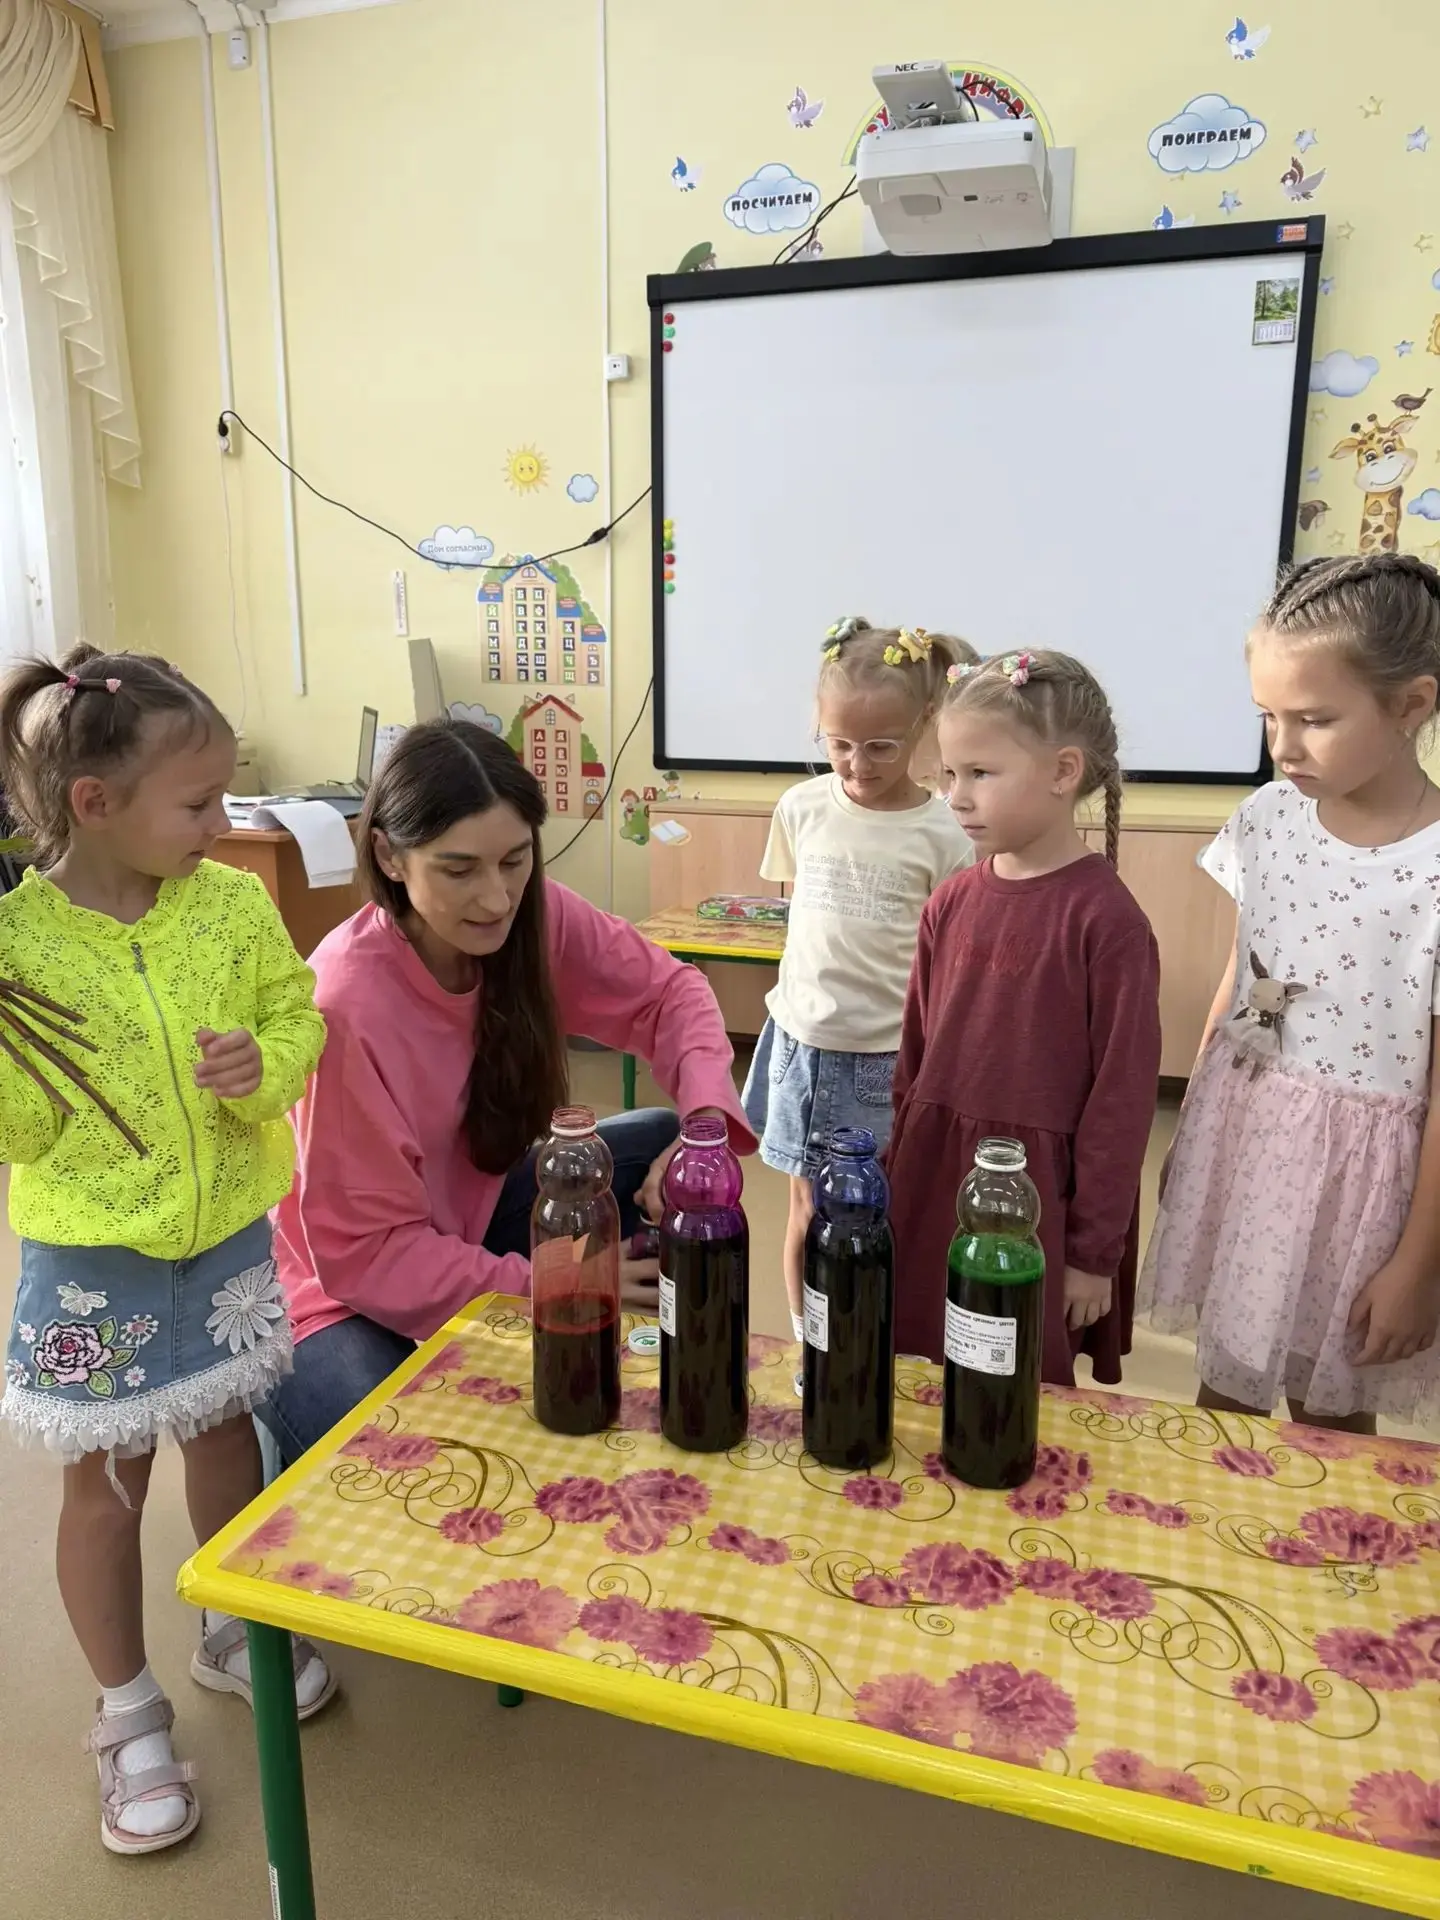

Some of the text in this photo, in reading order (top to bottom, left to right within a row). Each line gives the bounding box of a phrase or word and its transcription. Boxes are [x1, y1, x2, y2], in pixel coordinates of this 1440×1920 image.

[894, 62, 919, 72] NEC
[1161, 127, 1252, 147] ПОИГРАЕМ
[731, 192, 813, 212] ПОСЧИТАЕМ
[427, 543, 488, 554] Дом согласных
